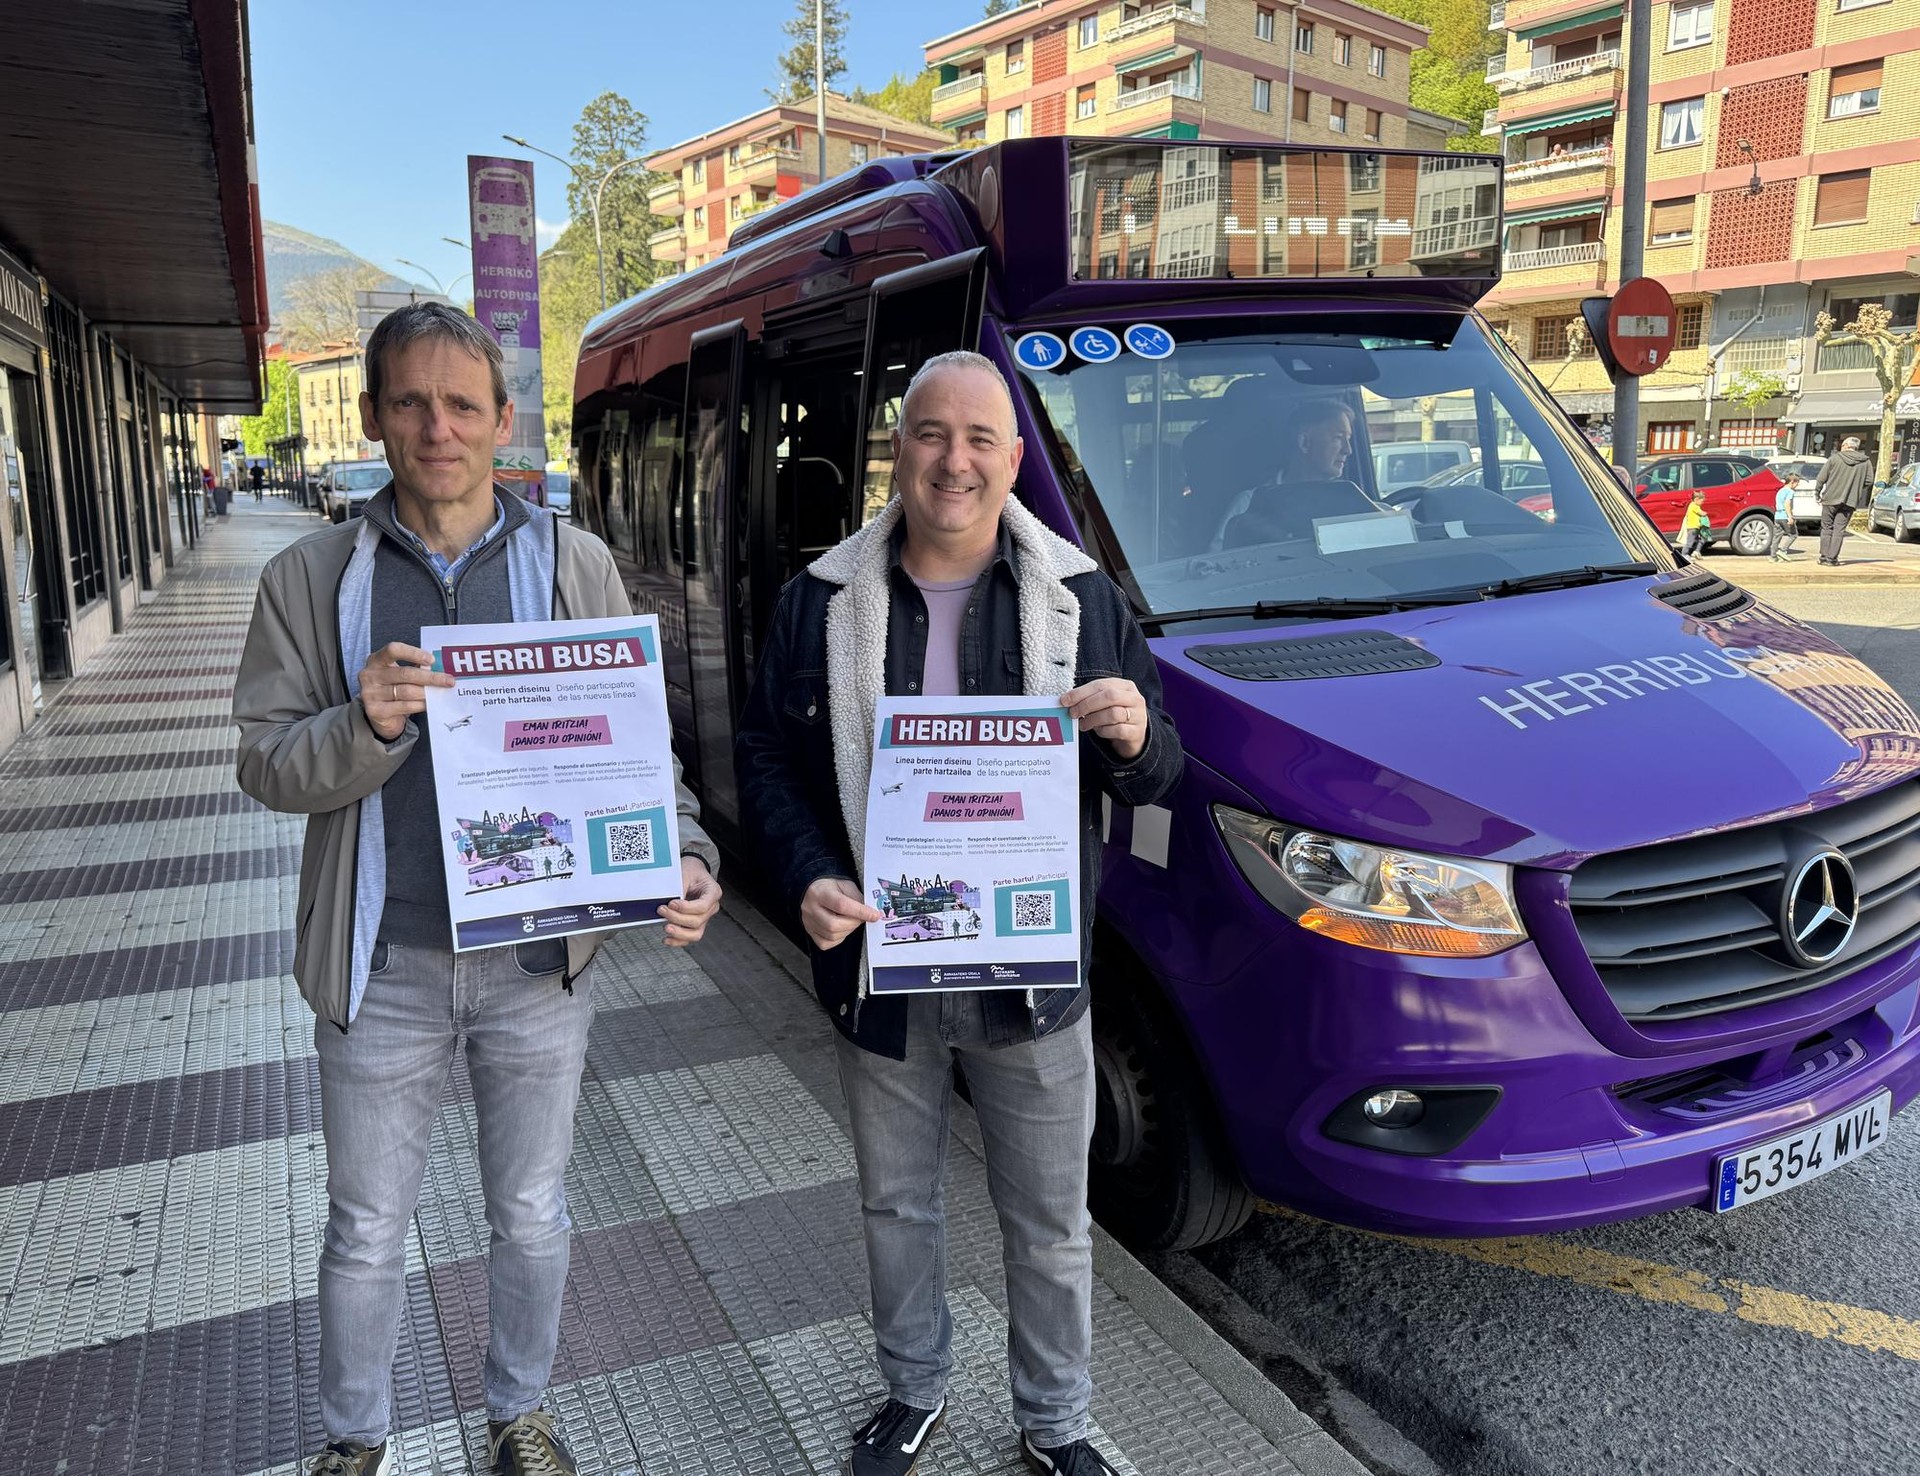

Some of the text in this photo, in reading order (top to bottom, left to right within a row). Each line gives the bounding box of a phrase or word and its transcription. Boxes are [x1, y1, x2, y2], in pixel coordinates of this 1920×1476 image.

[480, 266, 533, 279] HERRIKO
[0, 266, 43, 333] IOLETTA
[476, 288, 539, 302] AUTOBUSA
[452, 642, 634, 672] HERRI BUSA
[458, 685, 550, 696] Linea berrien diseinu
[556, 680, 635, 692] Diseño participativo
[1478, 645, 1815, 729] HERRIBUSA
[483, 695, 551, 706] parte hartzailea
[558, 693, 568, 701] de
[570, 693, 581, 701] las
[523, 719, 589, 731] EMAN IRITZIA!
[899, 719, 1052, 742] HERRI BUSA
[511, 730, 601, 747] ¡DANOS TU OPINIÓN!
[917, 756, 942, 765] berrien
[944, 757, 971, 765] diseinu
[977, 757, 1050, 768] Diseño participativo
[913, 768, 971, 776] parte hartzailea
[942, 795, 1002, 804] EMAN IRITZIA!
[585, 798, 663, 818] Parte hartu! ¡Participa!
[931, 806, 1014, 818] ¡DANOS TU OPINIÓN!
[1013, 876, 1034, 884] hartu!
[1743, 1107, 1880, 1195] 5354 MVL
[1724, 1189, 1730, 1201] E
